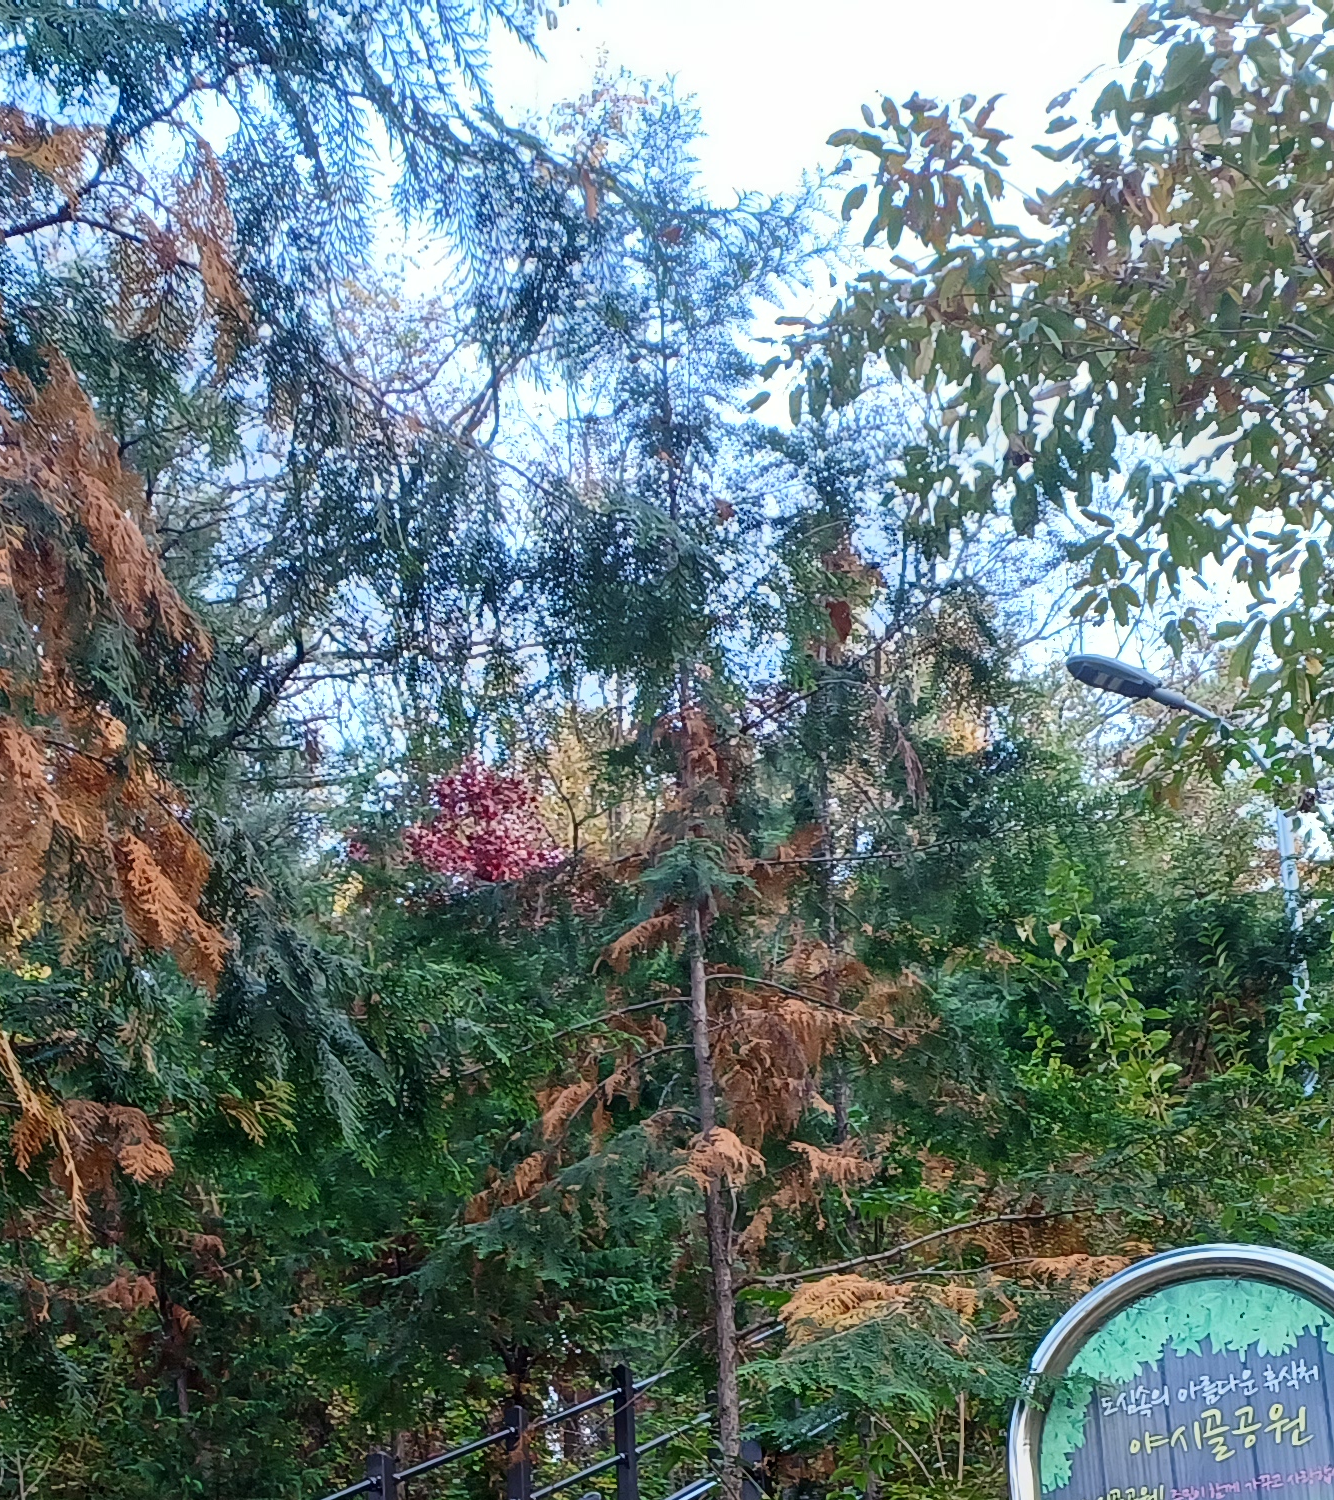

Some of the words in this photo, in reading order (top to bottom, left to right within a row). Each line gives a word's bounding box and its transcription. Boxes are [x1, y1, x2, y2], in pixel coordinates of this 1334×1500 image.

[1100, 1385, 1169, 1418] 도심속의
[1177, 1369, 1259, 1406] 아름다운
[1263, 1358, 1319, 1393] 휴식처
[1129, 1403, 1315, 1462] 야시골공원
